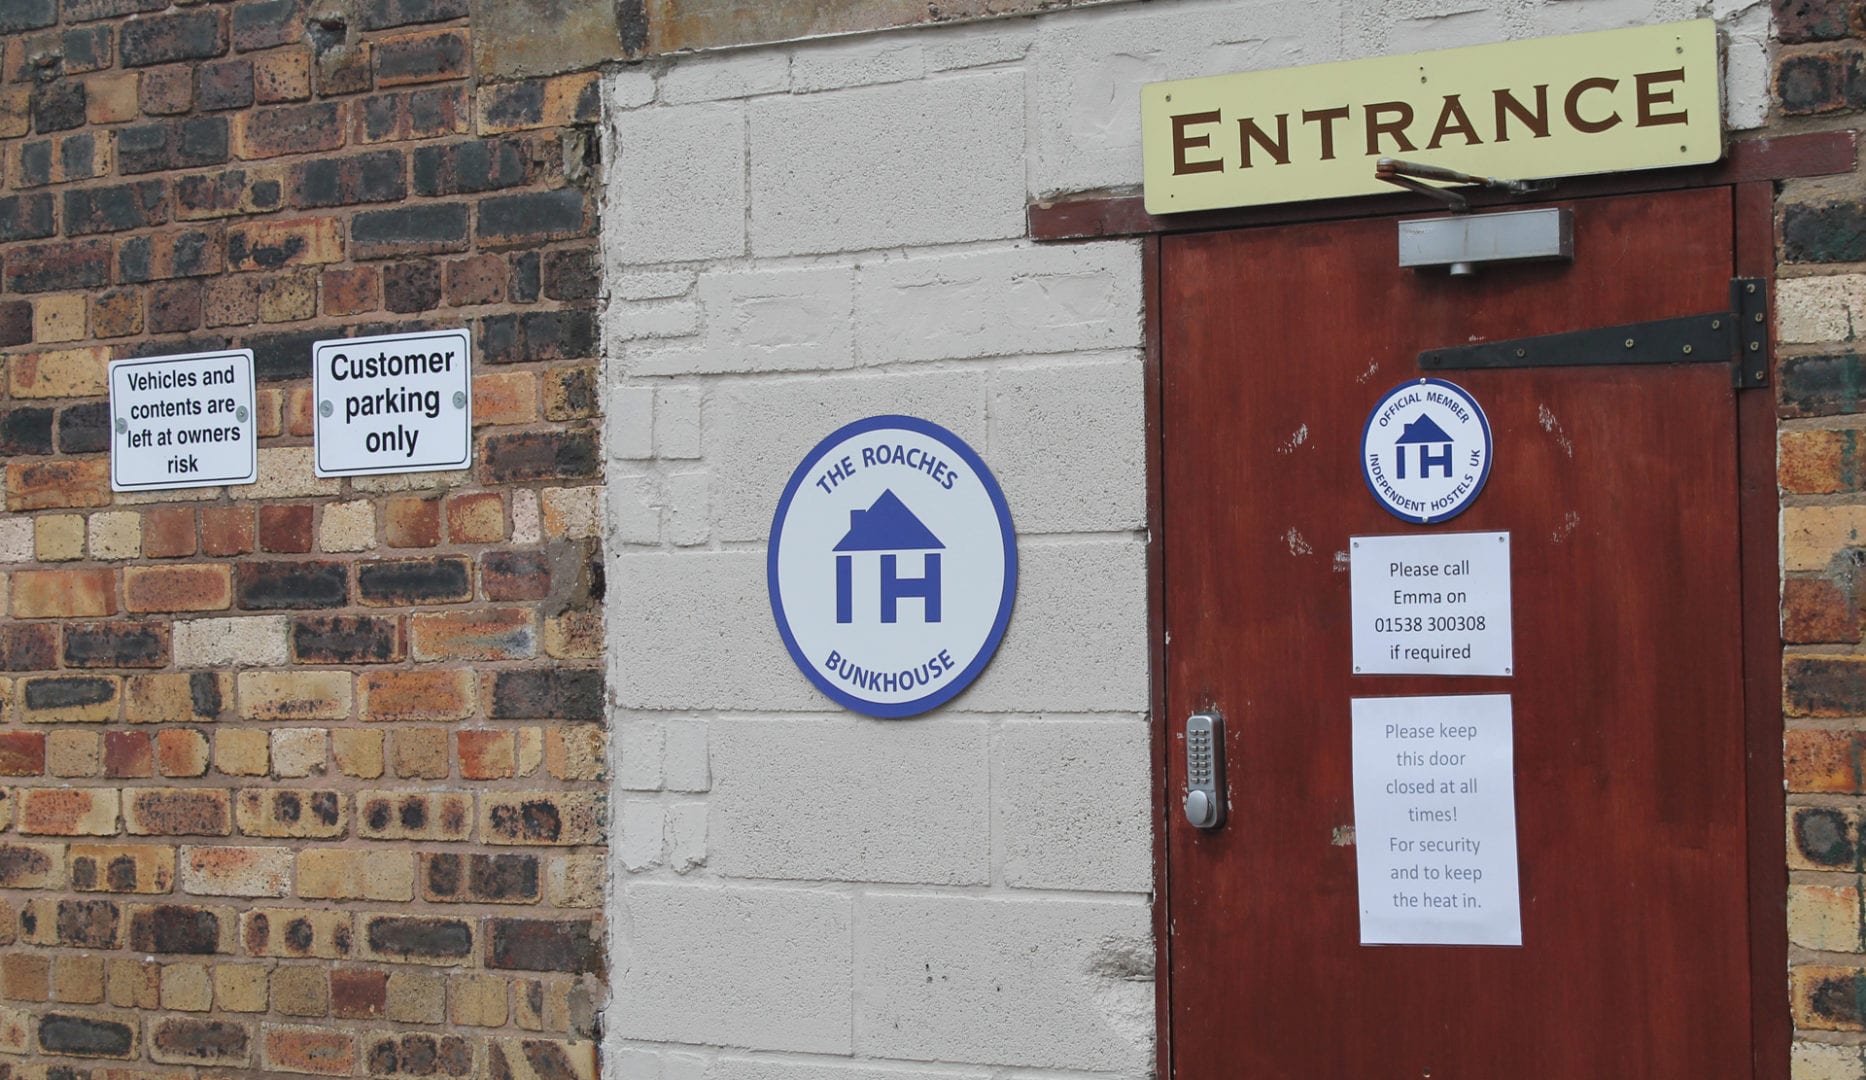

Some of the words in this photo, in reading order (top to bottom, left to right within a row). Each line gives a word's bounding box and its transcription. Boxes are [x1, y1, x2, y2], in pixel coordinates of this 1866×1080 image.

[1170, 66, 1689, 176] ENTRANCE
[331, 350, 455, 381] Customer
[127, 368, 197, 391] Vehicles
[202, 365, 235, 386] and
[130, 397, 201, 420] contents
[207, 397, 236, 413] are
[346, 387, 440, 423] parking
[1379, 392, 1422, 427] OFFICIAL
[1426, 392, 1470, 424] MEMBER
[127, 429, 153, 448] left
[157, 428, 172, 446] at
[177, 424, 241, 444] owners
[366, 425, 419, 457] only
[167, 455, 198, 474] risk
[816, 456, 857, 494] THE
[862, 444, 958, 490] ROACHES
[1370, 453, 1426, 512] INDEPENDENT
[1430, 474, 1474, 511] HOSTELS
[1469, 449, 1481, 467] UK
[1390, 561, 1439, 577] Please
[1443, 560, 1469, 576] call
[1394, 590, 1442, 605] Emma
[1446, 591, 1467, 604] on
[1374, 617, 1423, 632] 01538
[1427, 616, 1486, 632] 300308
[1390, 644, 1401, 660] if
[1404, 643, 1471, 663] required
[824, 648, 955, 692] BUNKHOUSE
[1385, 724, 1435, 739] Please
[1439, 722, 1478, 741] keep
[1396, 750, 1425, 766] this
[1429, 750, 1466, 766] door
[1386, 778, 1435, 794] closed
[1440, 779, 1455, 794] at
[1459, 778, 1478, 794] all
[1408, 806, 1458, 822] times!
[1389, 837, 1415, 852] For
[1419, 836, 1481, 856] security
[1390, 864, 1419, 880] and
[1423, 866, 1440, 880] to
[1444, 864, 1483, 884] keep
[1392, 892, 1419, 908] the
[1423, 892, 1458, 908] heat
[1462, 893, 1482, 908] in.
